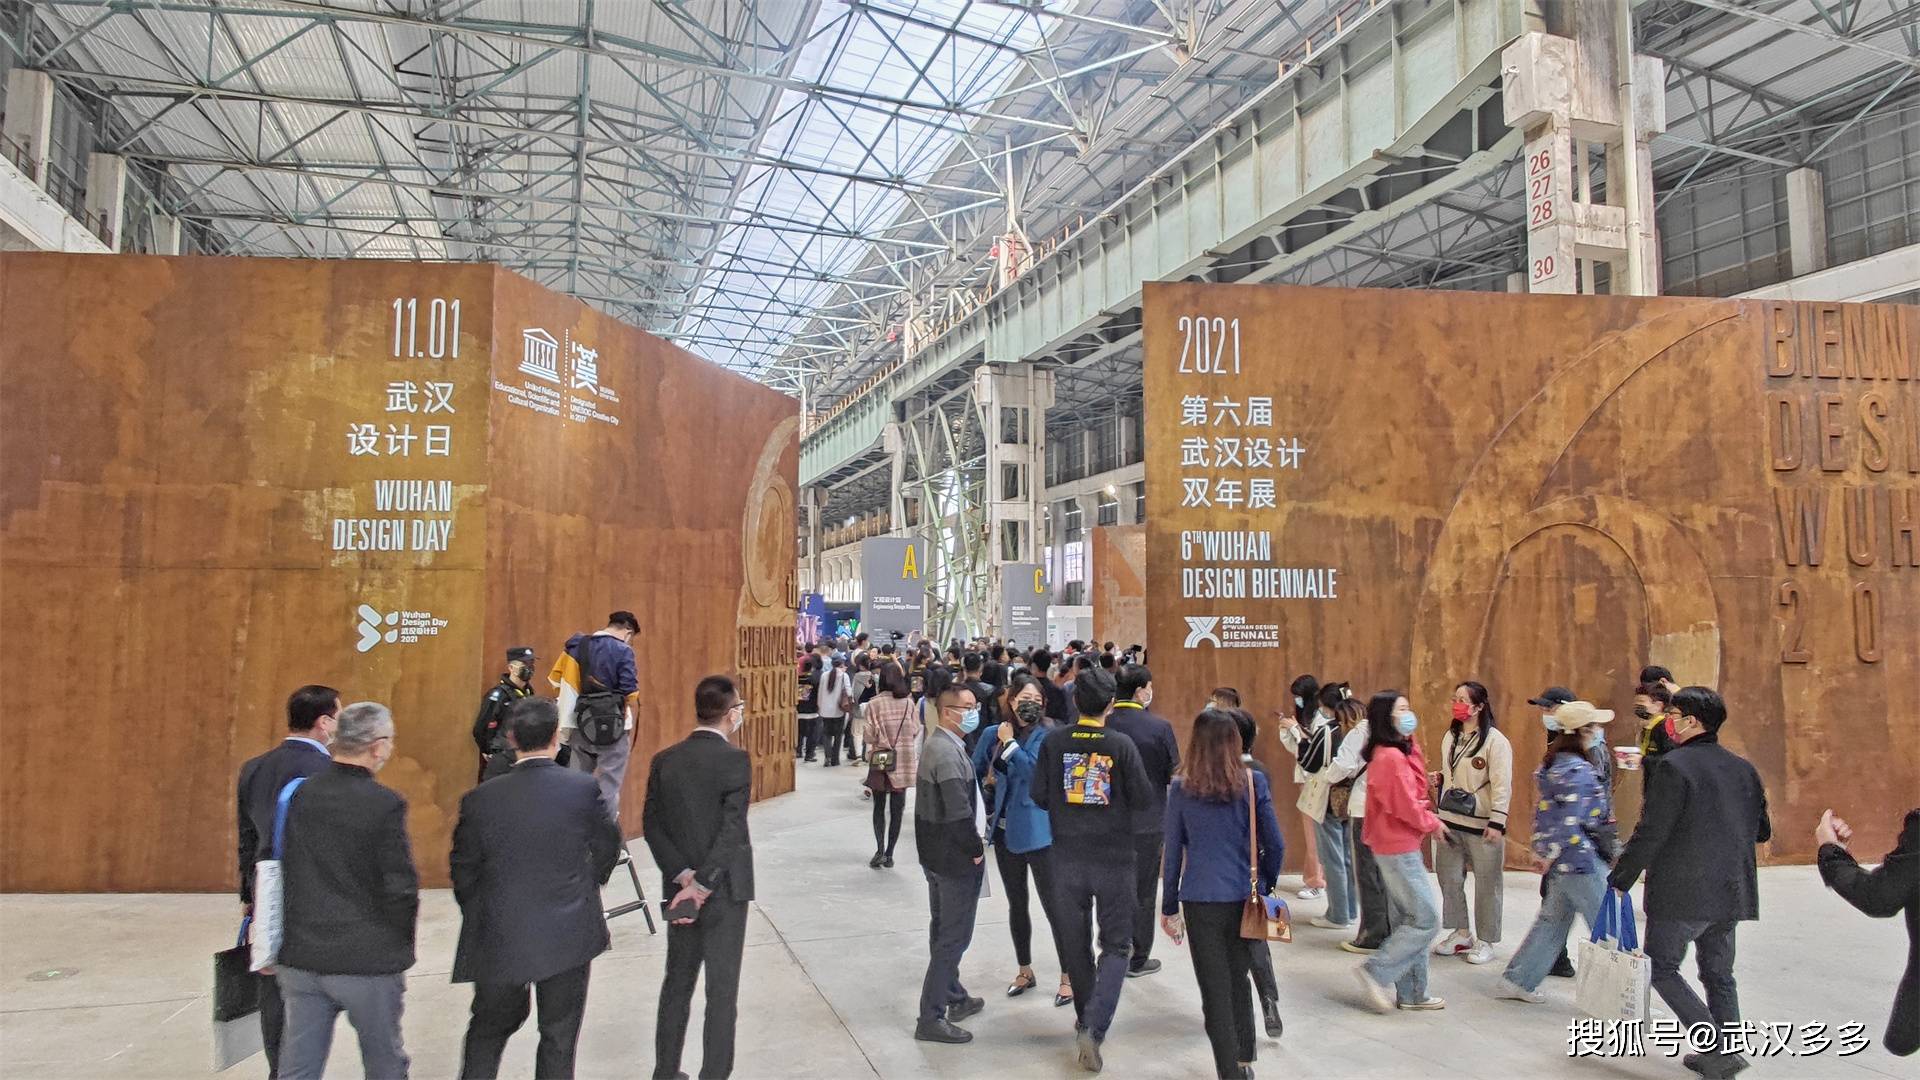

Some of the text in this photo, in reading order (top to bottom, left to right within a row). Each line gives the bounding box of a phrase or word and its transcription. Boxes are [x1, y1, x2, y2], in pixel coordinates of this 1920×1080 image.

[1530, 150, 1550, 176] 26
[1532, 175, 1550, 200] 27
[1532, 200, 1552, 225] 28
[1534, 256, 1553, 279] 30
[393, 297, 461, 359] 11.01
[1767, 303, 1920, 379] BIENN
[1178, 316, 1241, 375] 2021
[385, 379, 455, 414] 武汉
[1180, 394, 1273, 427] 第六届
[346, 422, 451, 457] 设计日
[1181, 437, 1306, 469] 武汉设计
[374, 479, 452, 512] WUHAN
[1181, 477, 1276, 510] 双年展
[332, 518, 452, 551] DESIGN DAY
[902, 544, 919, 579] A
[1034, 568, 1044, 593] C
[1182, 568, 1337, 600] DESIGN BIENNALE
[401, 611, 431, 619] Wuhan
[805, 596, 811, 610] F
[401, 618, 449, 627] Design Day
[1222, 616, 1246, 624] 2021
[1222, 631, 1278, 640] BIENNALE
[400, 635, 418, 643] 2021
